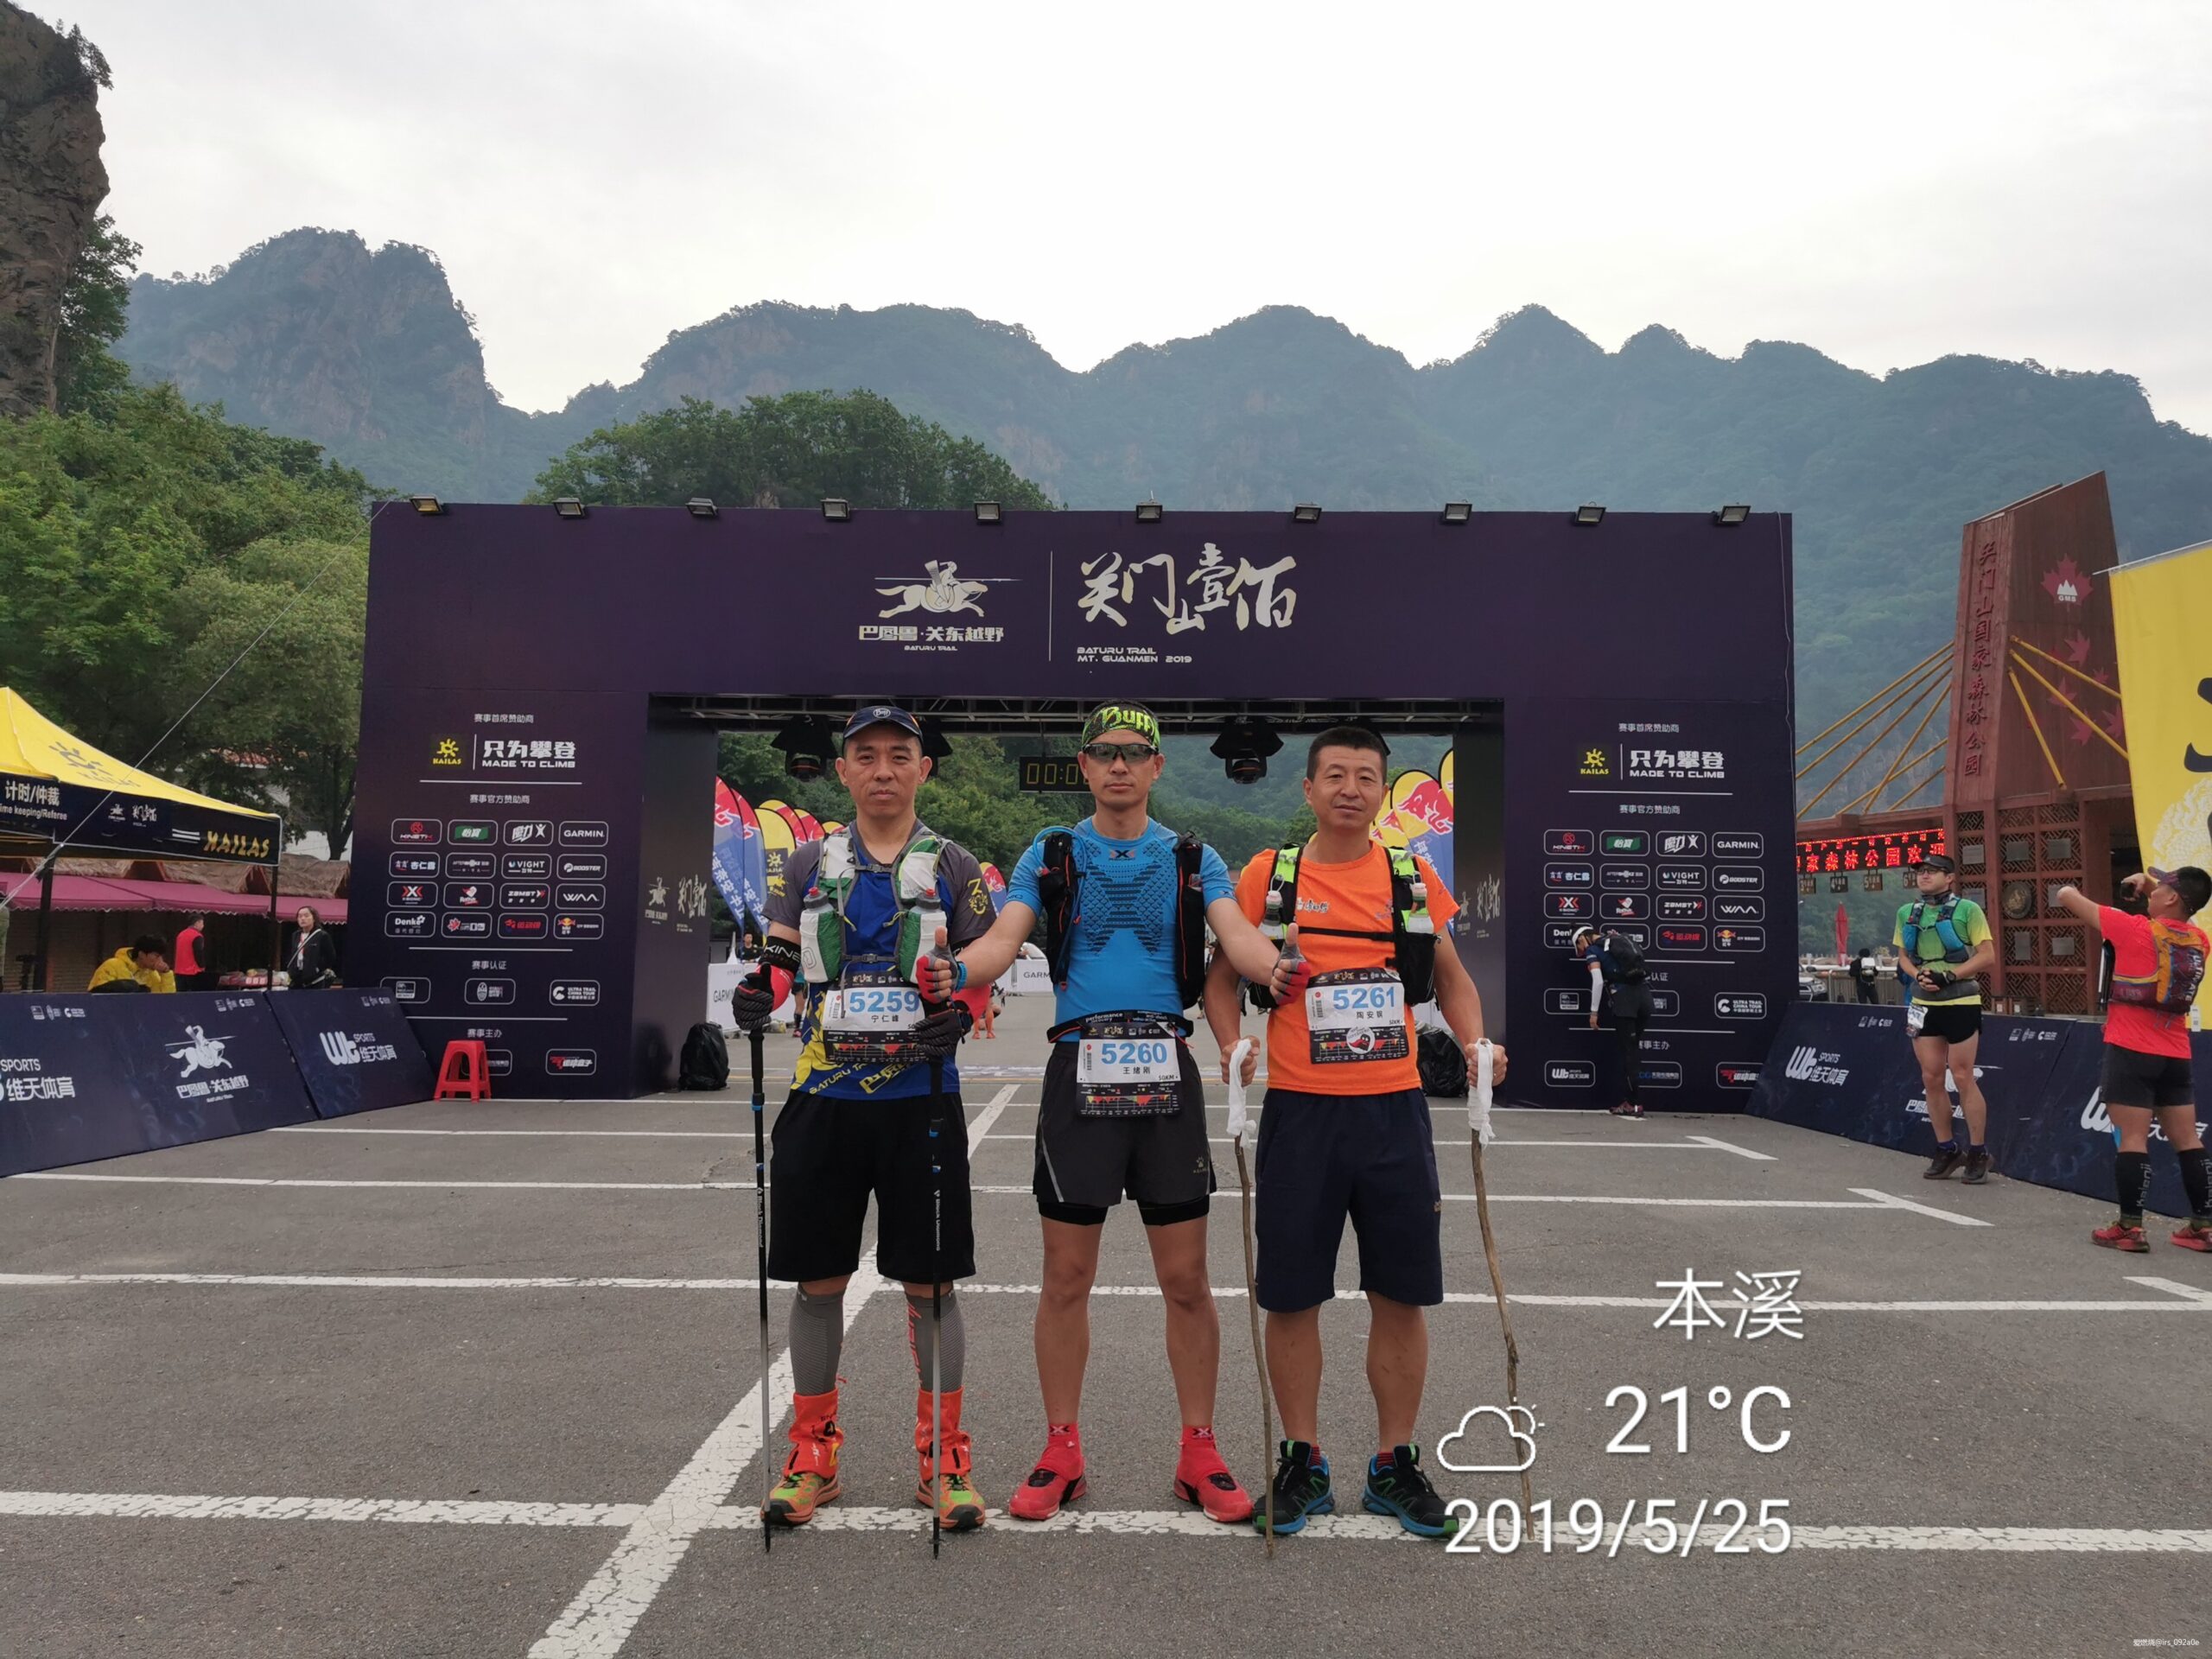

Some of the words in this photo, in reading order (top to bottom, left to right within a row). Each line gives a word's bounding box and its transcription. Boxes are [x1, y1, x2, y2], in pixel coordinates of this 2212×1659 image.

[474, 714, 534, 723] 赛事首席赞助商
[1618, 723, 1680, 733] 赛事首席赞助商
[483, 741, 576, 759] 只为攀登
[1630, 750, 1725, 769] 只为攀登
[4, 780, 60, 805] 计时/仲裁
[470, 794, 530, 804] 赛事官方赞助商
[0, 804, 13, 815] ime
[1619, 804, 1680, 814] 赛事官方赞助商
[1717, 841, 1759, 849] GARMIN
[472, 961, 506, 969] 赛事认证
[1650, 972, 1669, 982] 认证
[849, 991, 920, 1013] 5259
[1333, 987, 1395, 1010] 5261
[467, 1028, 502, 1038] 赛事主办
[1102, 1043, 1167, 1065] 5260
[1818, 1052, 1840, 1063] SPORTS
[0, 1058, 41, 1071] SPORTS
[6, 1077, 75, 1101] 维天体育
